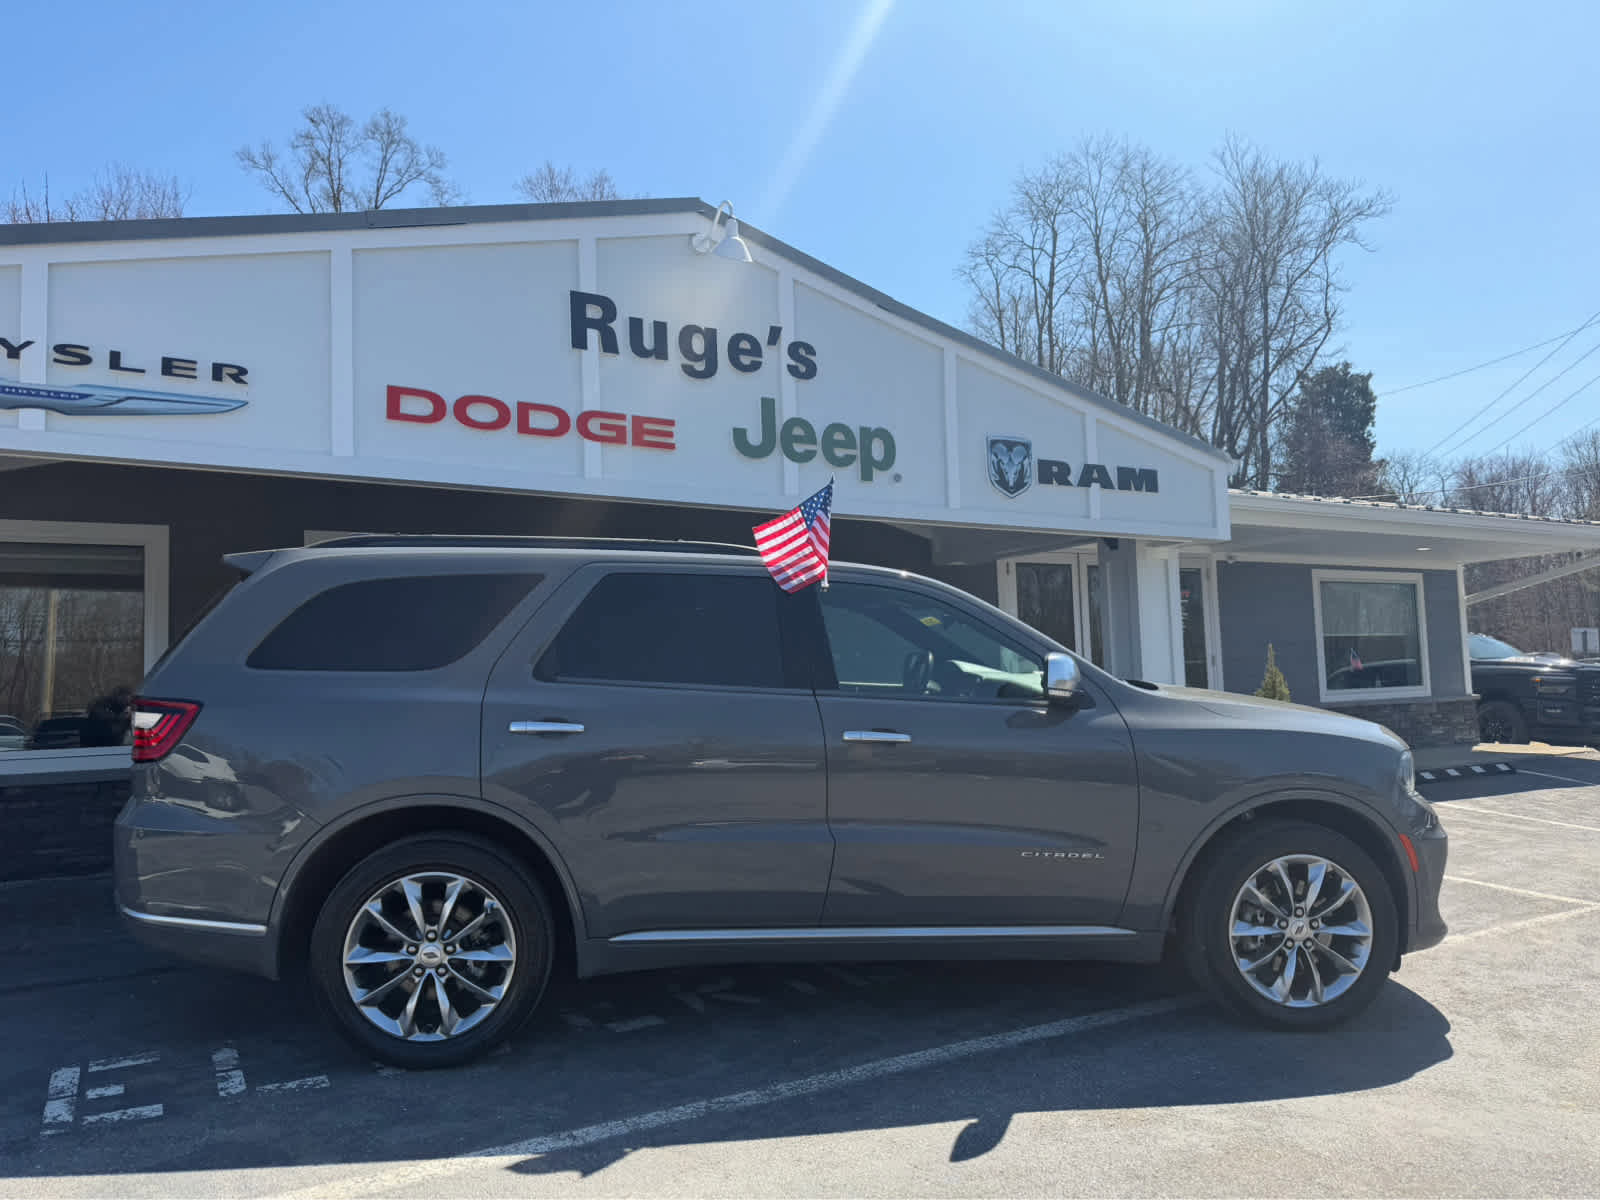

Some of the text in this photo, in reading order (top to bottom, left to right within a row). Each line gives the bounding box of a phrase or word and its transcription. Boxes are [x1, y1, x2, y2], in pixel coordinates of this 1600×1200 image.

[569, 289, 818, 380] Ruge's
[386, 384, 676, 450] DODGE
[732, 397, 897, 482] Jeep
[1037, 458, 1159, 493] RAM
[1020, 850, 1105, 860] CITADEL
